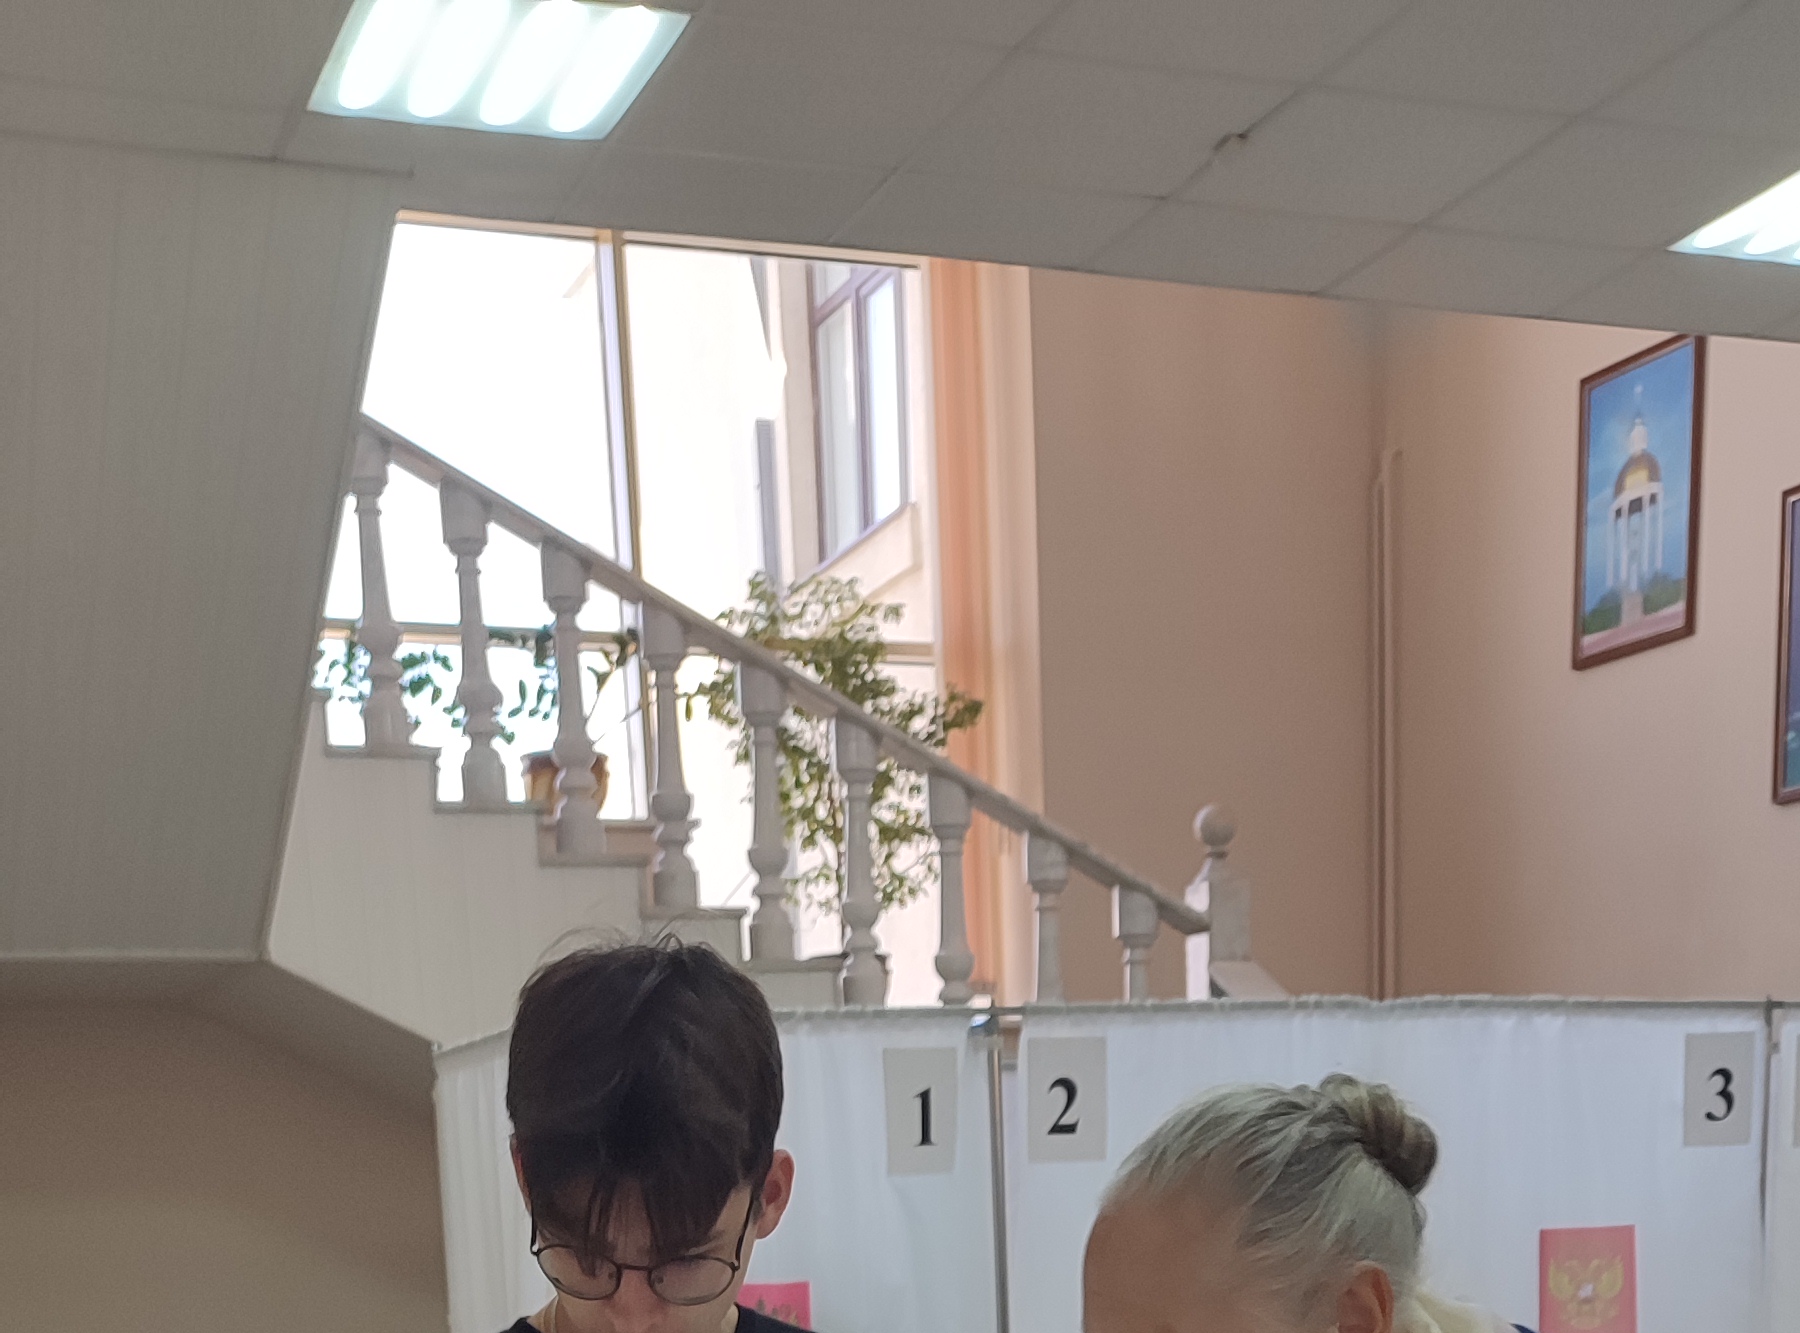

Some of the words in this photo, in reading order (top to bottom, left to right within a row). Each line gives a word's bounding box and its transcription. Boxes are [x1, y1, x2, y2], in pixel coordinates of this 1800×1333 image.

[913, 1086, 936, 1146] 1
[1047, 1077, 1080, 1135] 2
[1704, 1067, 1735, 1122] 3
